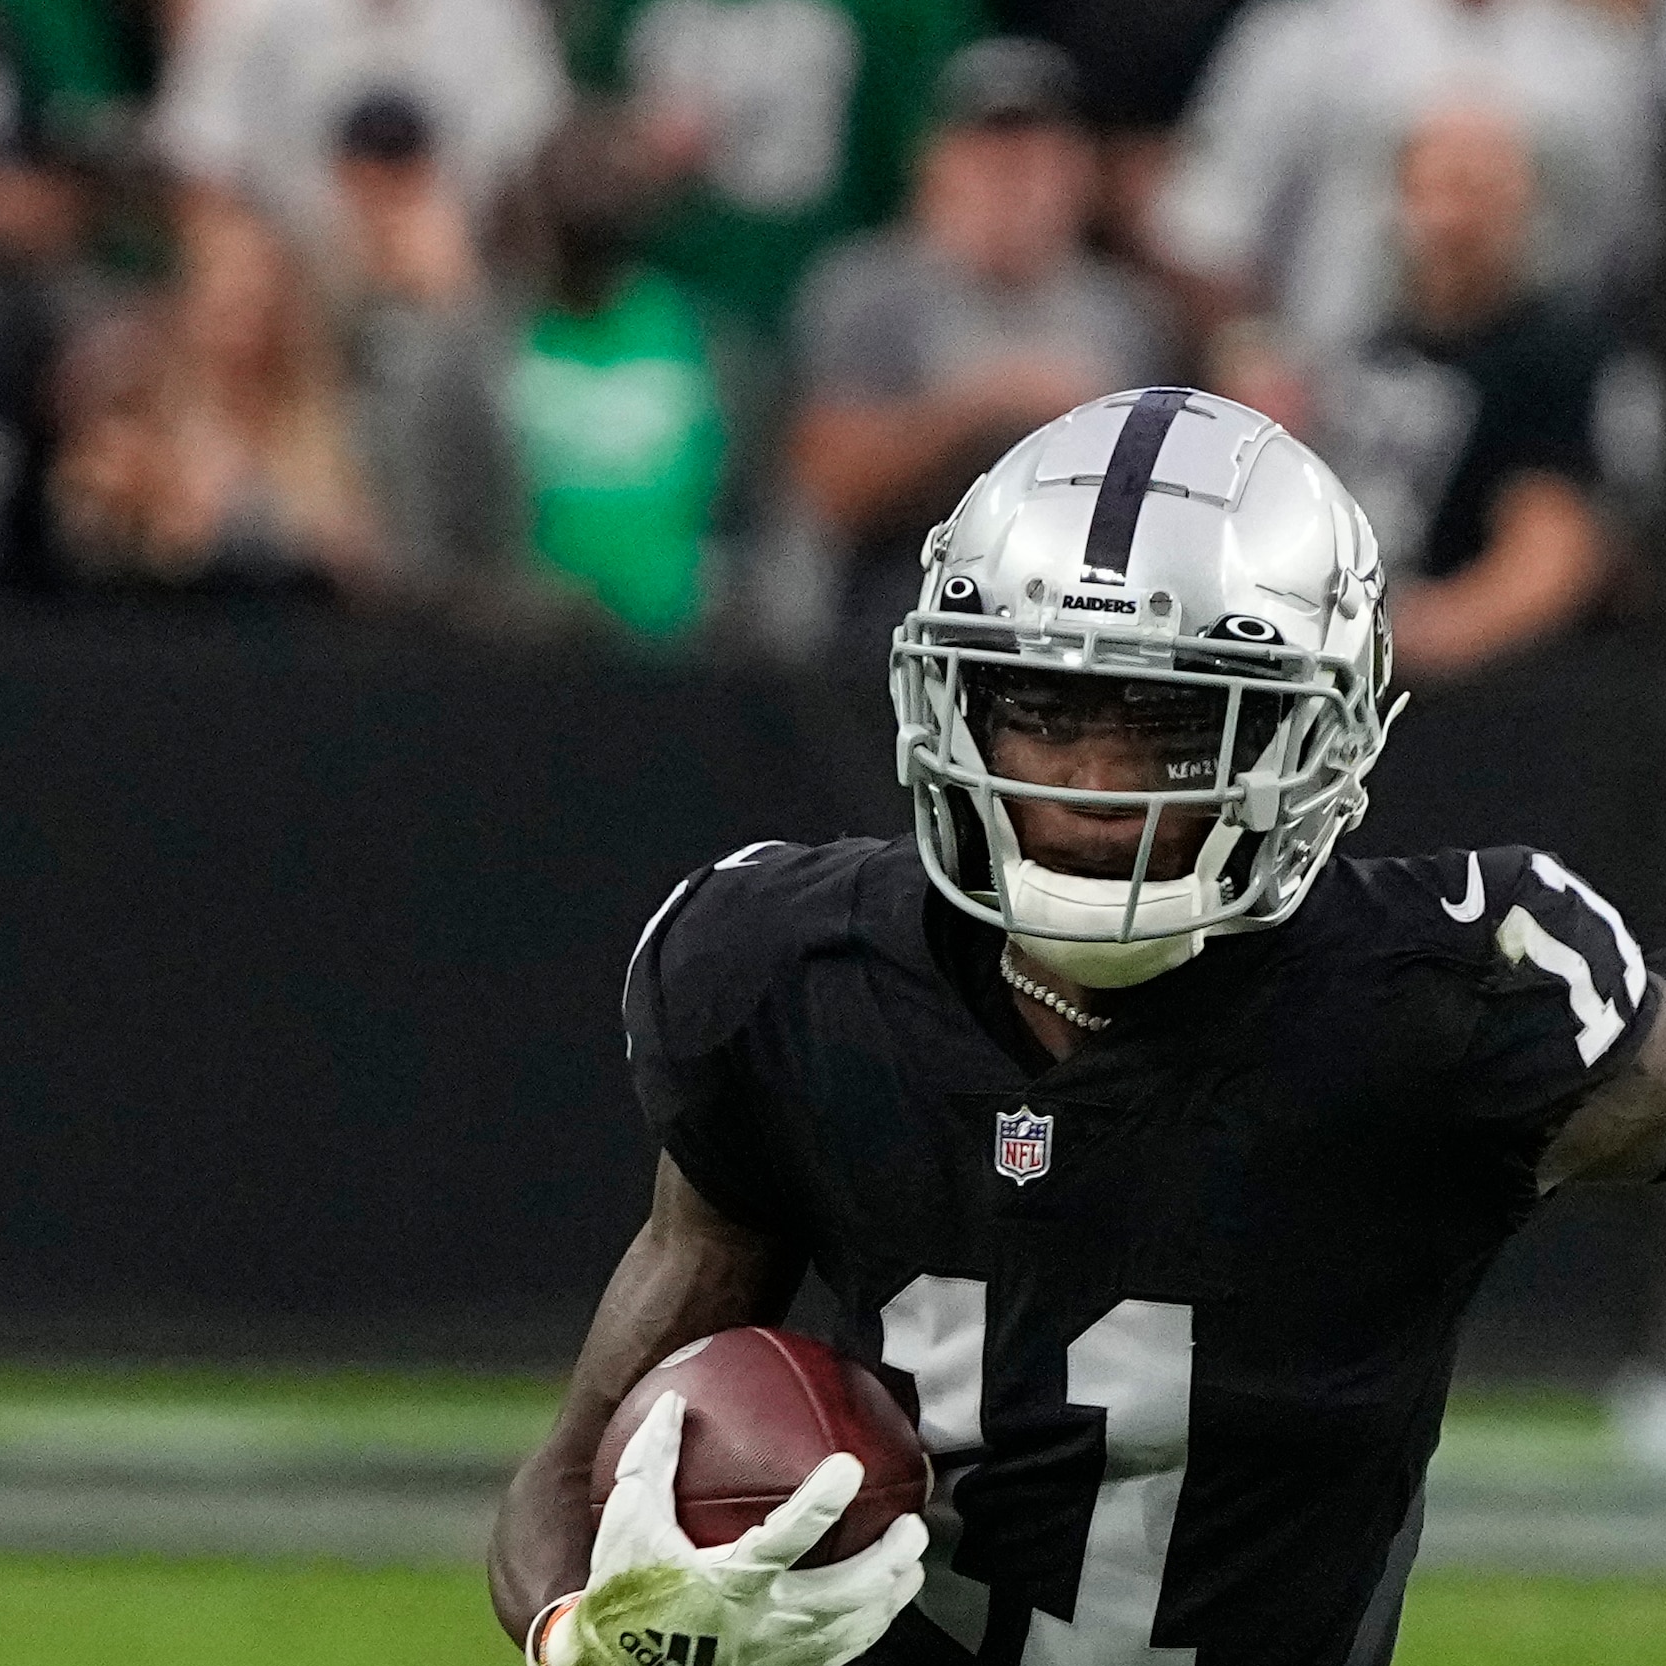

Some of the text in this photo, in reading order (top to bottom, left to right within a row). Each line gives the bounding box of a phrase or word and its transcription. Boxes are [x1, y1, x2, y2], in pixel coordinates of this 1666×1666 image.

[1062, 594, 1137, 614] RAIDERS
[1495, 852, 1648, 1068] 11
[1004, 1141, 1041, 1170] NFL
